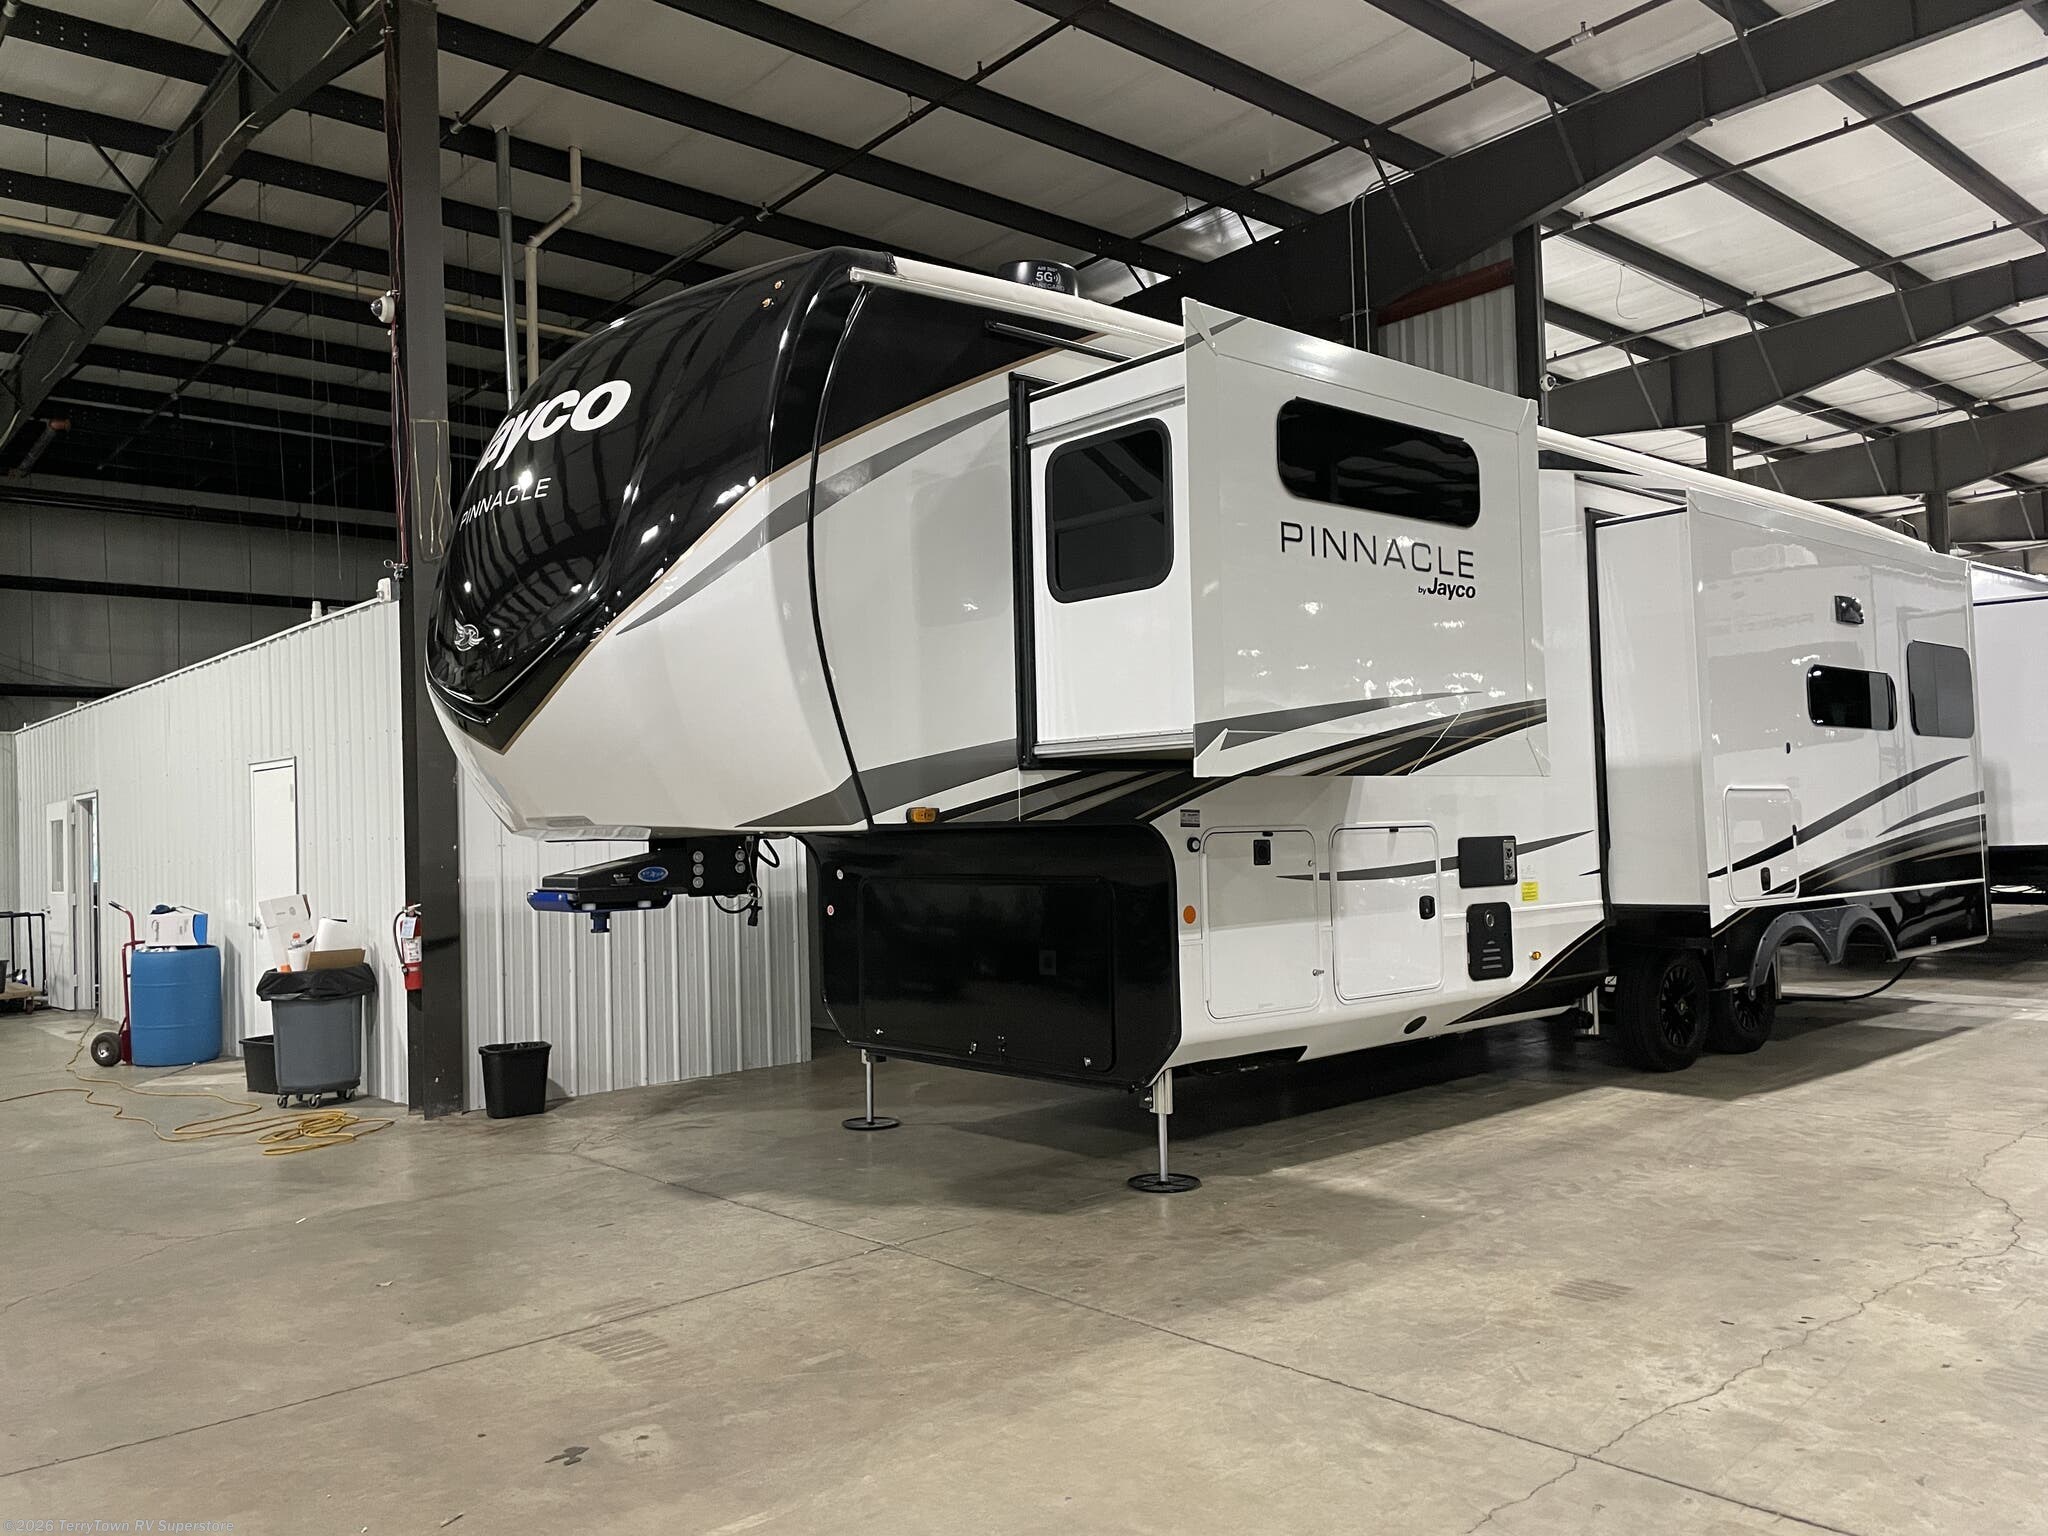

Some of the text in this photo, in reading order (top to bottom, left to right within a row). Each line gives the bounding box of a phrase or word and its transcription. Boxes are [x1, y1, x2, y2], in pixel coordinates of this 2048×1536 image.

[1035, 271, 1053, 282] 5G
[474, 380, 632, 471] ayco
[459, 478, 552, 531] PINNACLE
[1280, 521, 1475, 579] PINNACLE
[1418, 577, 1476, 600] by Jayco
